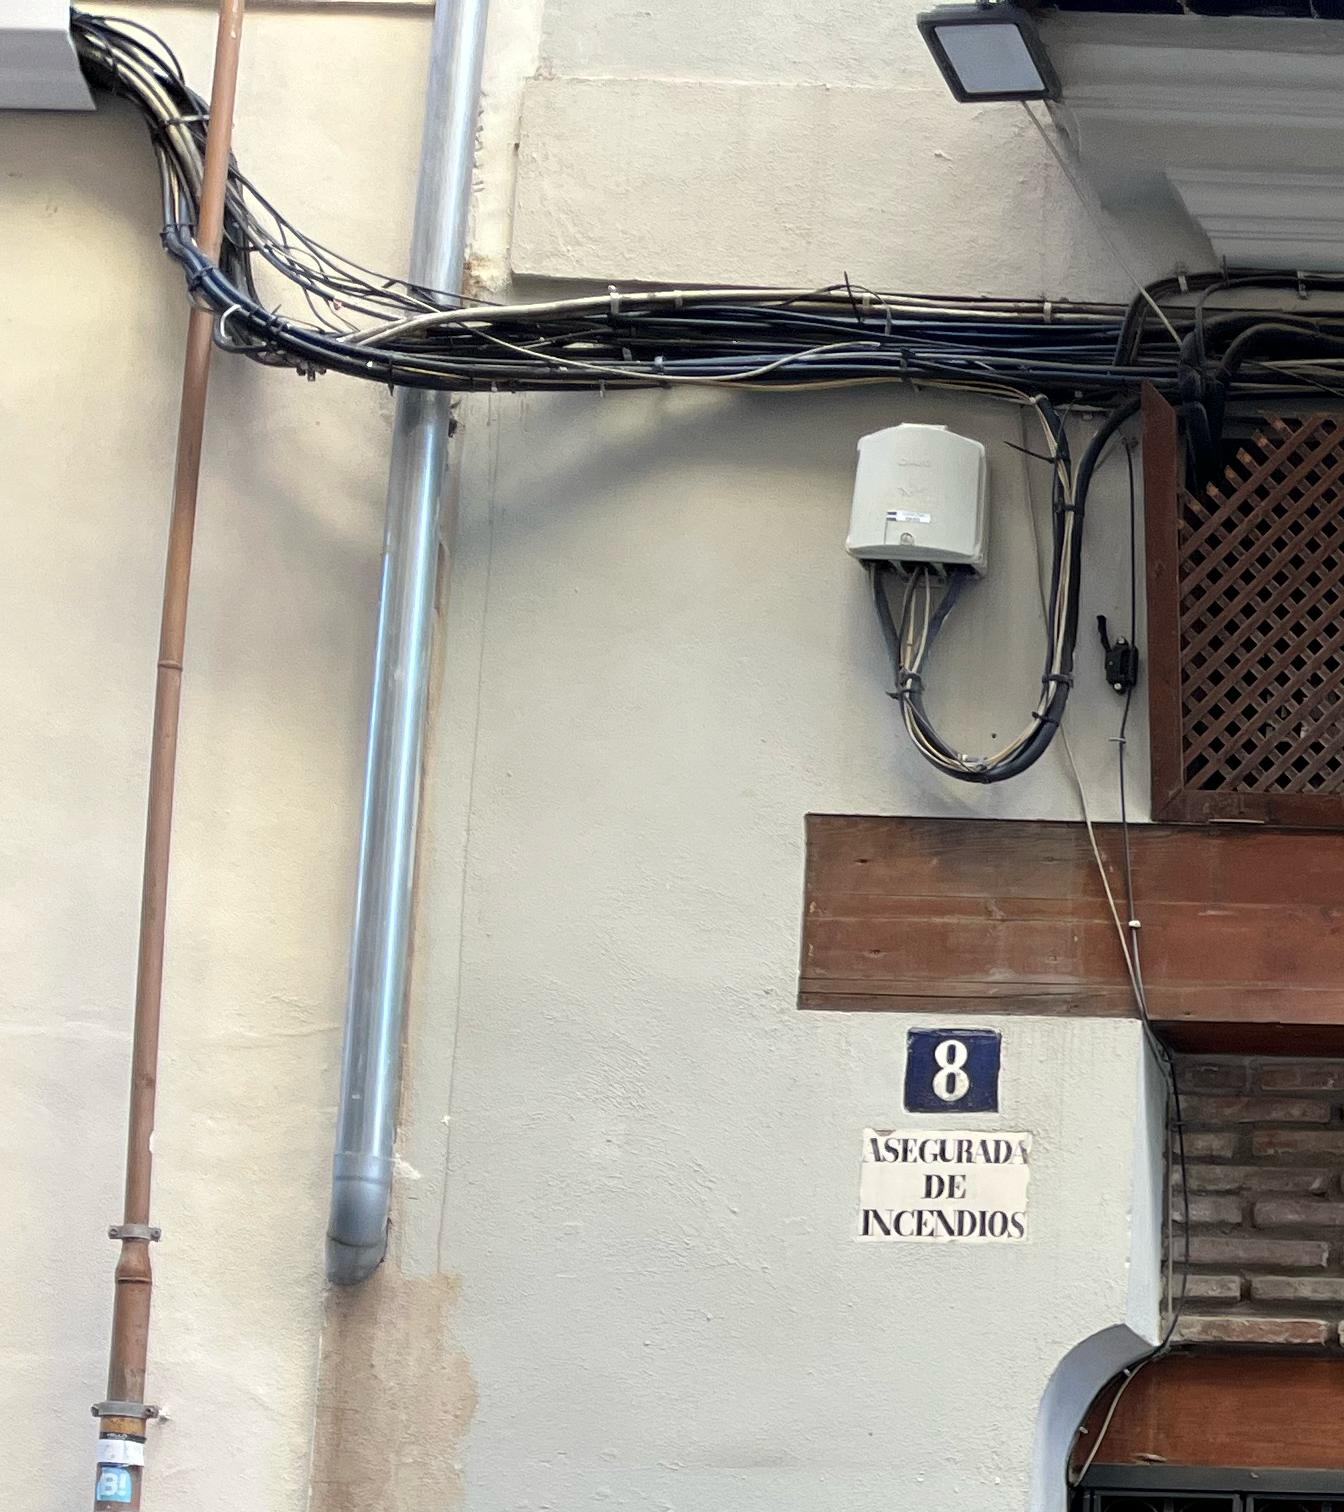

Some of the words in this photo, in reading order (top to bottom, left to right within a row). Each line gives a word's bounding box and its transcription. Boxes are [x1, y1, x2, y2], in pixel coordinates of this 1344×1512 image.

[932, 1039, 970, 1102] 8
[862, 1137, 1030, 1165] ASEGURADA
[921, 1174, 967, 1199] DE
[858, 1209, 1027, 1239] INCENDIOS
